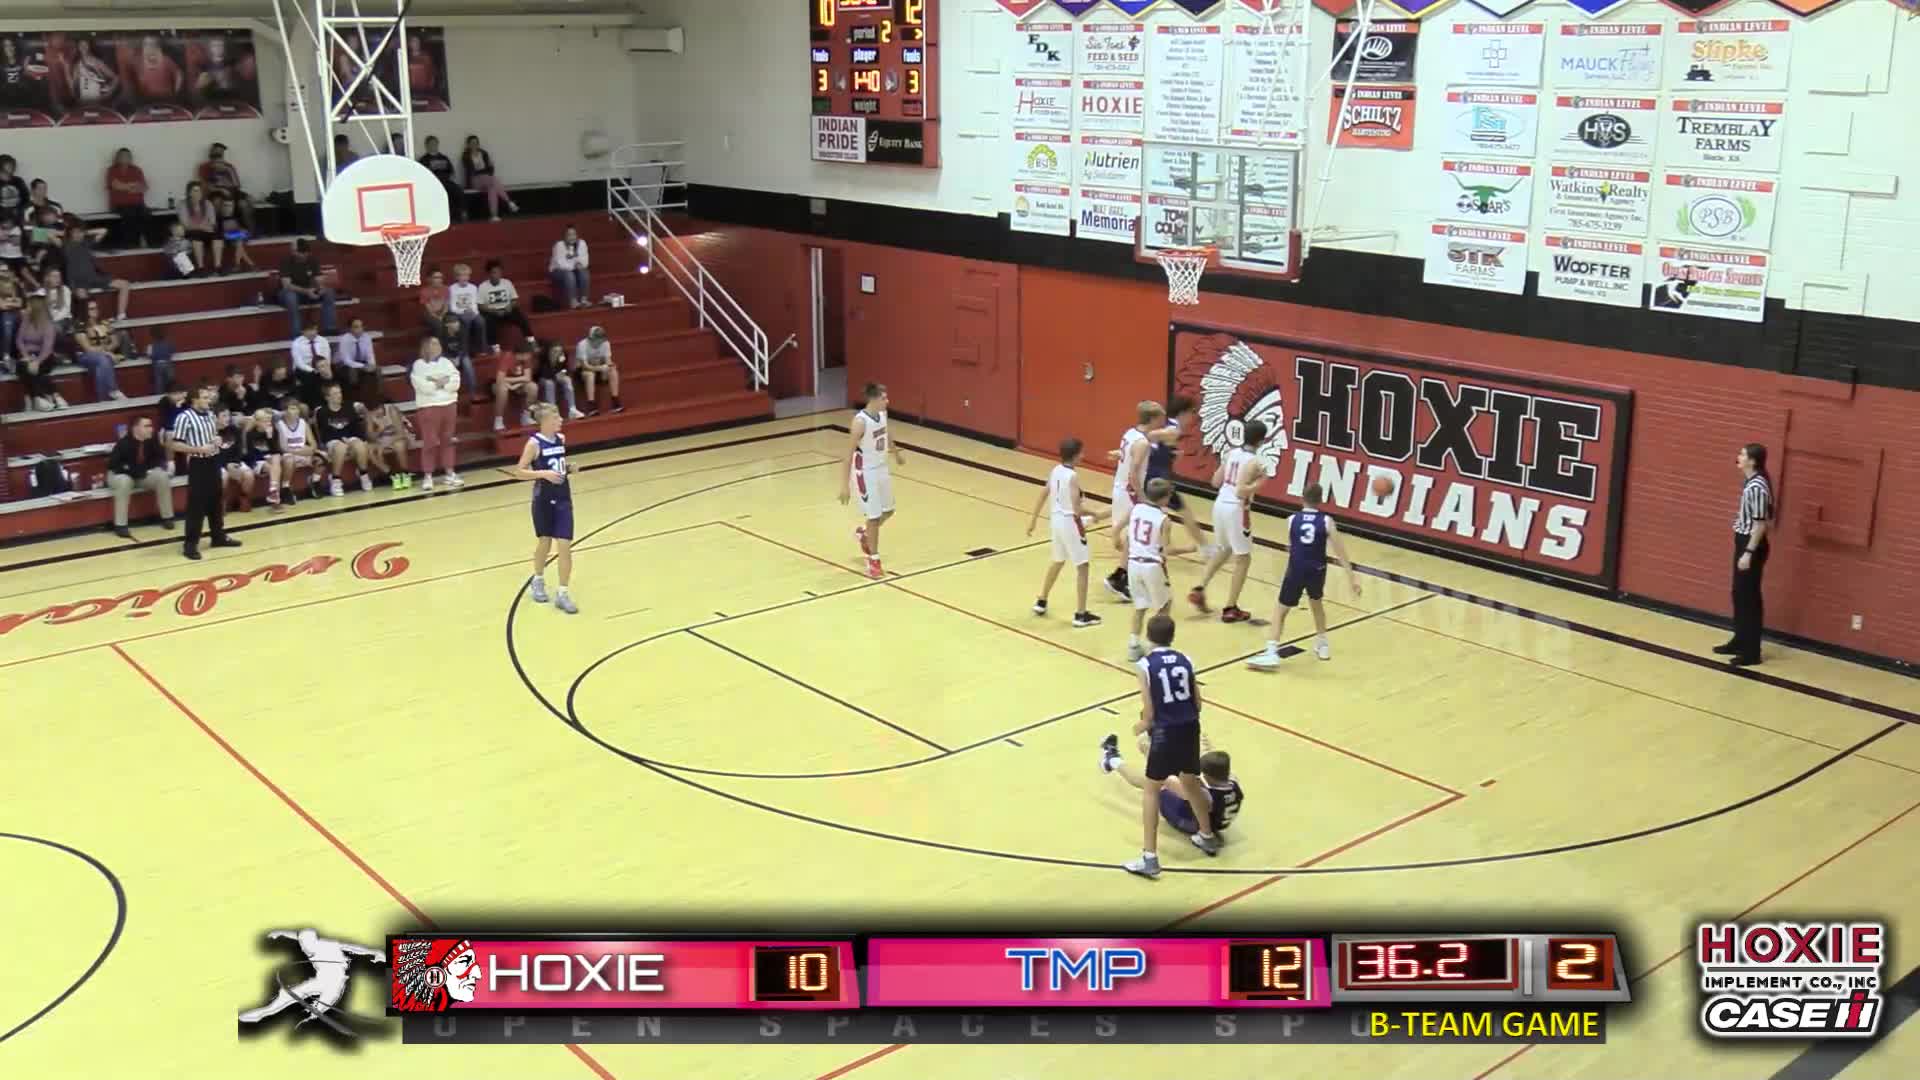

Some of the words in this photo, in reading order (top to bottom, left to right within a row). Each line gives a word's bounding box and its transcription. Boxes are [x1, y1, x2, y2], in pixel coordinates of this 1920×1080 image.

[881, 20, 891, 43] 2
[1709, 23, 1742, 32] INDIAN
[1744, 22, 1773, 31] LEVEL
[854, 49, 877, 62] player
[1560, 57, 1617, 71] MAUCK
[819, 69, 828, 92] 3
[910, 70, 919, 93] 3
[1082, 95, 1143, 114] HOXIE
[818, 118, 858, 132] INDIAN
[1343, 104, 1402, 132] SCHILTZ
[1677, 116, 1777, 137] TREMBLAY
[818, 133, 858, 150] PRIDE
[1696, 138, 1751, 152] FARMS
[1085, 151, 1140, 169] Nutrien
[1551, 180, 1601, 195] Watkins
[1609, 183, 1649, 200] Realty
[1456, 263, 1496, 277] FARMS
[1553, 255, 1631, 279] WOOFTER
[1291, 356, 1602, 502] HOXIE
[1286, 449, 1589, 562] INDIANS
[1133, 517, 1153, 545] 13
[1299, 523, 1315, 544] 3
[1158, 665, 1191, 704] 13
